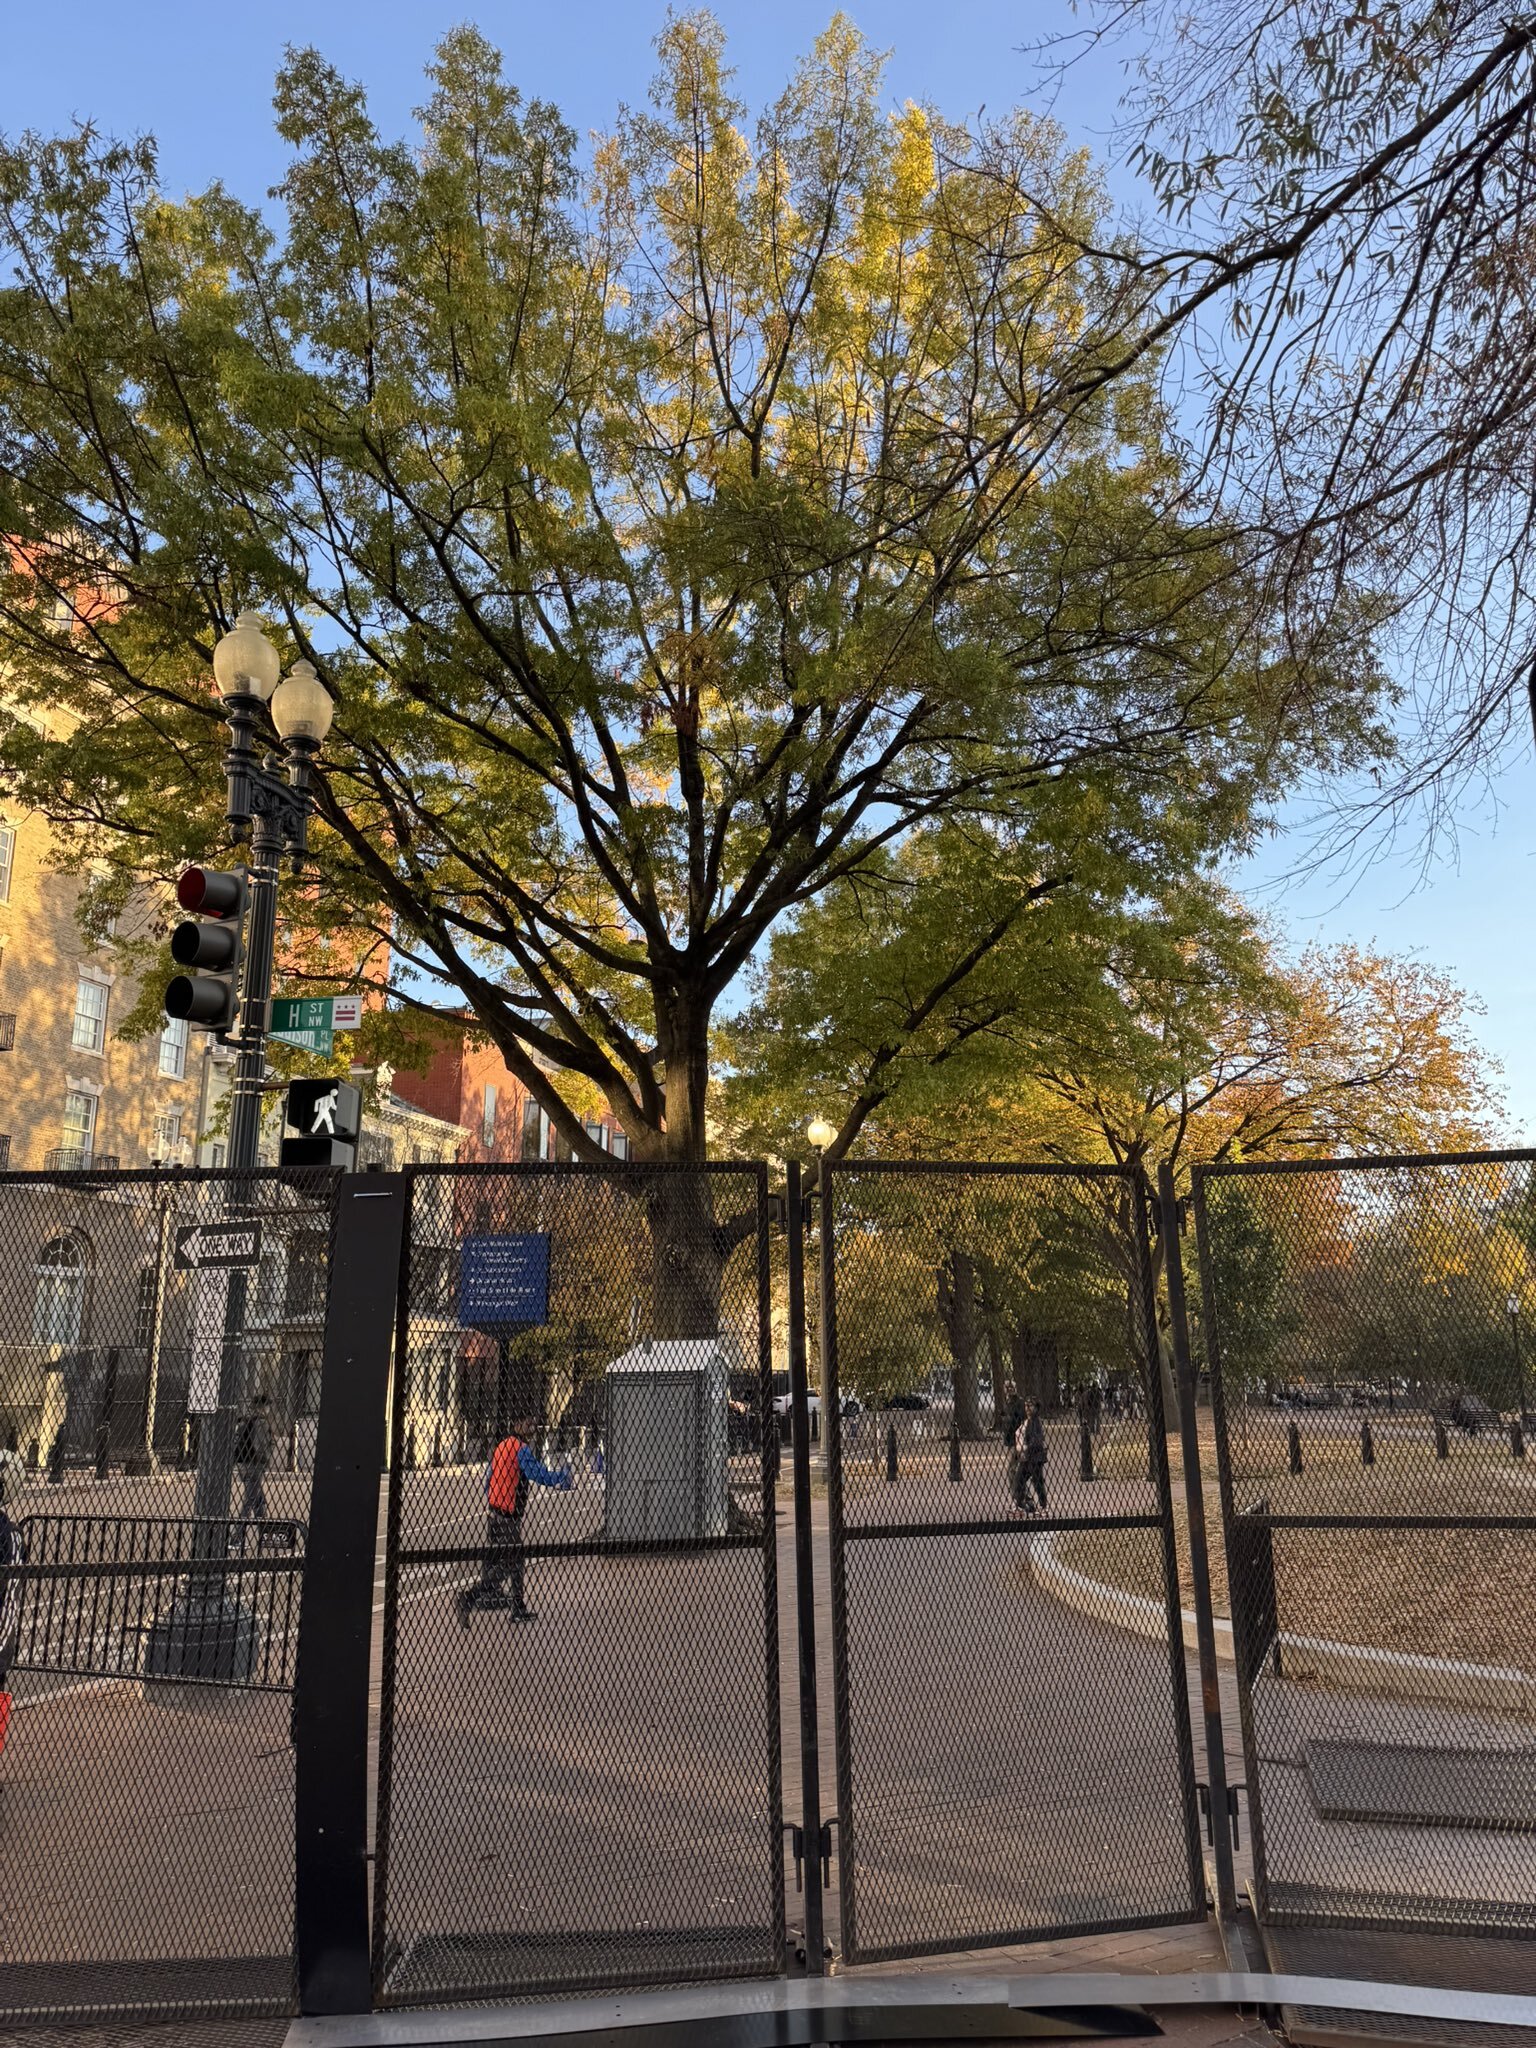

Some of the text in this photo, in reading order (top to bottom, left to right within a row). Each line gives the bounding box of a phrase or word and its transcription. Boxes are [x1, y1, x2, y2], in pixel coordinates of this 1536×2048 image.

[289, 1002, 324, 1028] H ST
[308, 1015, 323, 1027] NW
[269, 1030, 330, 1049] ison PL
[200, 1234, 254, 1256] ONE WAY
